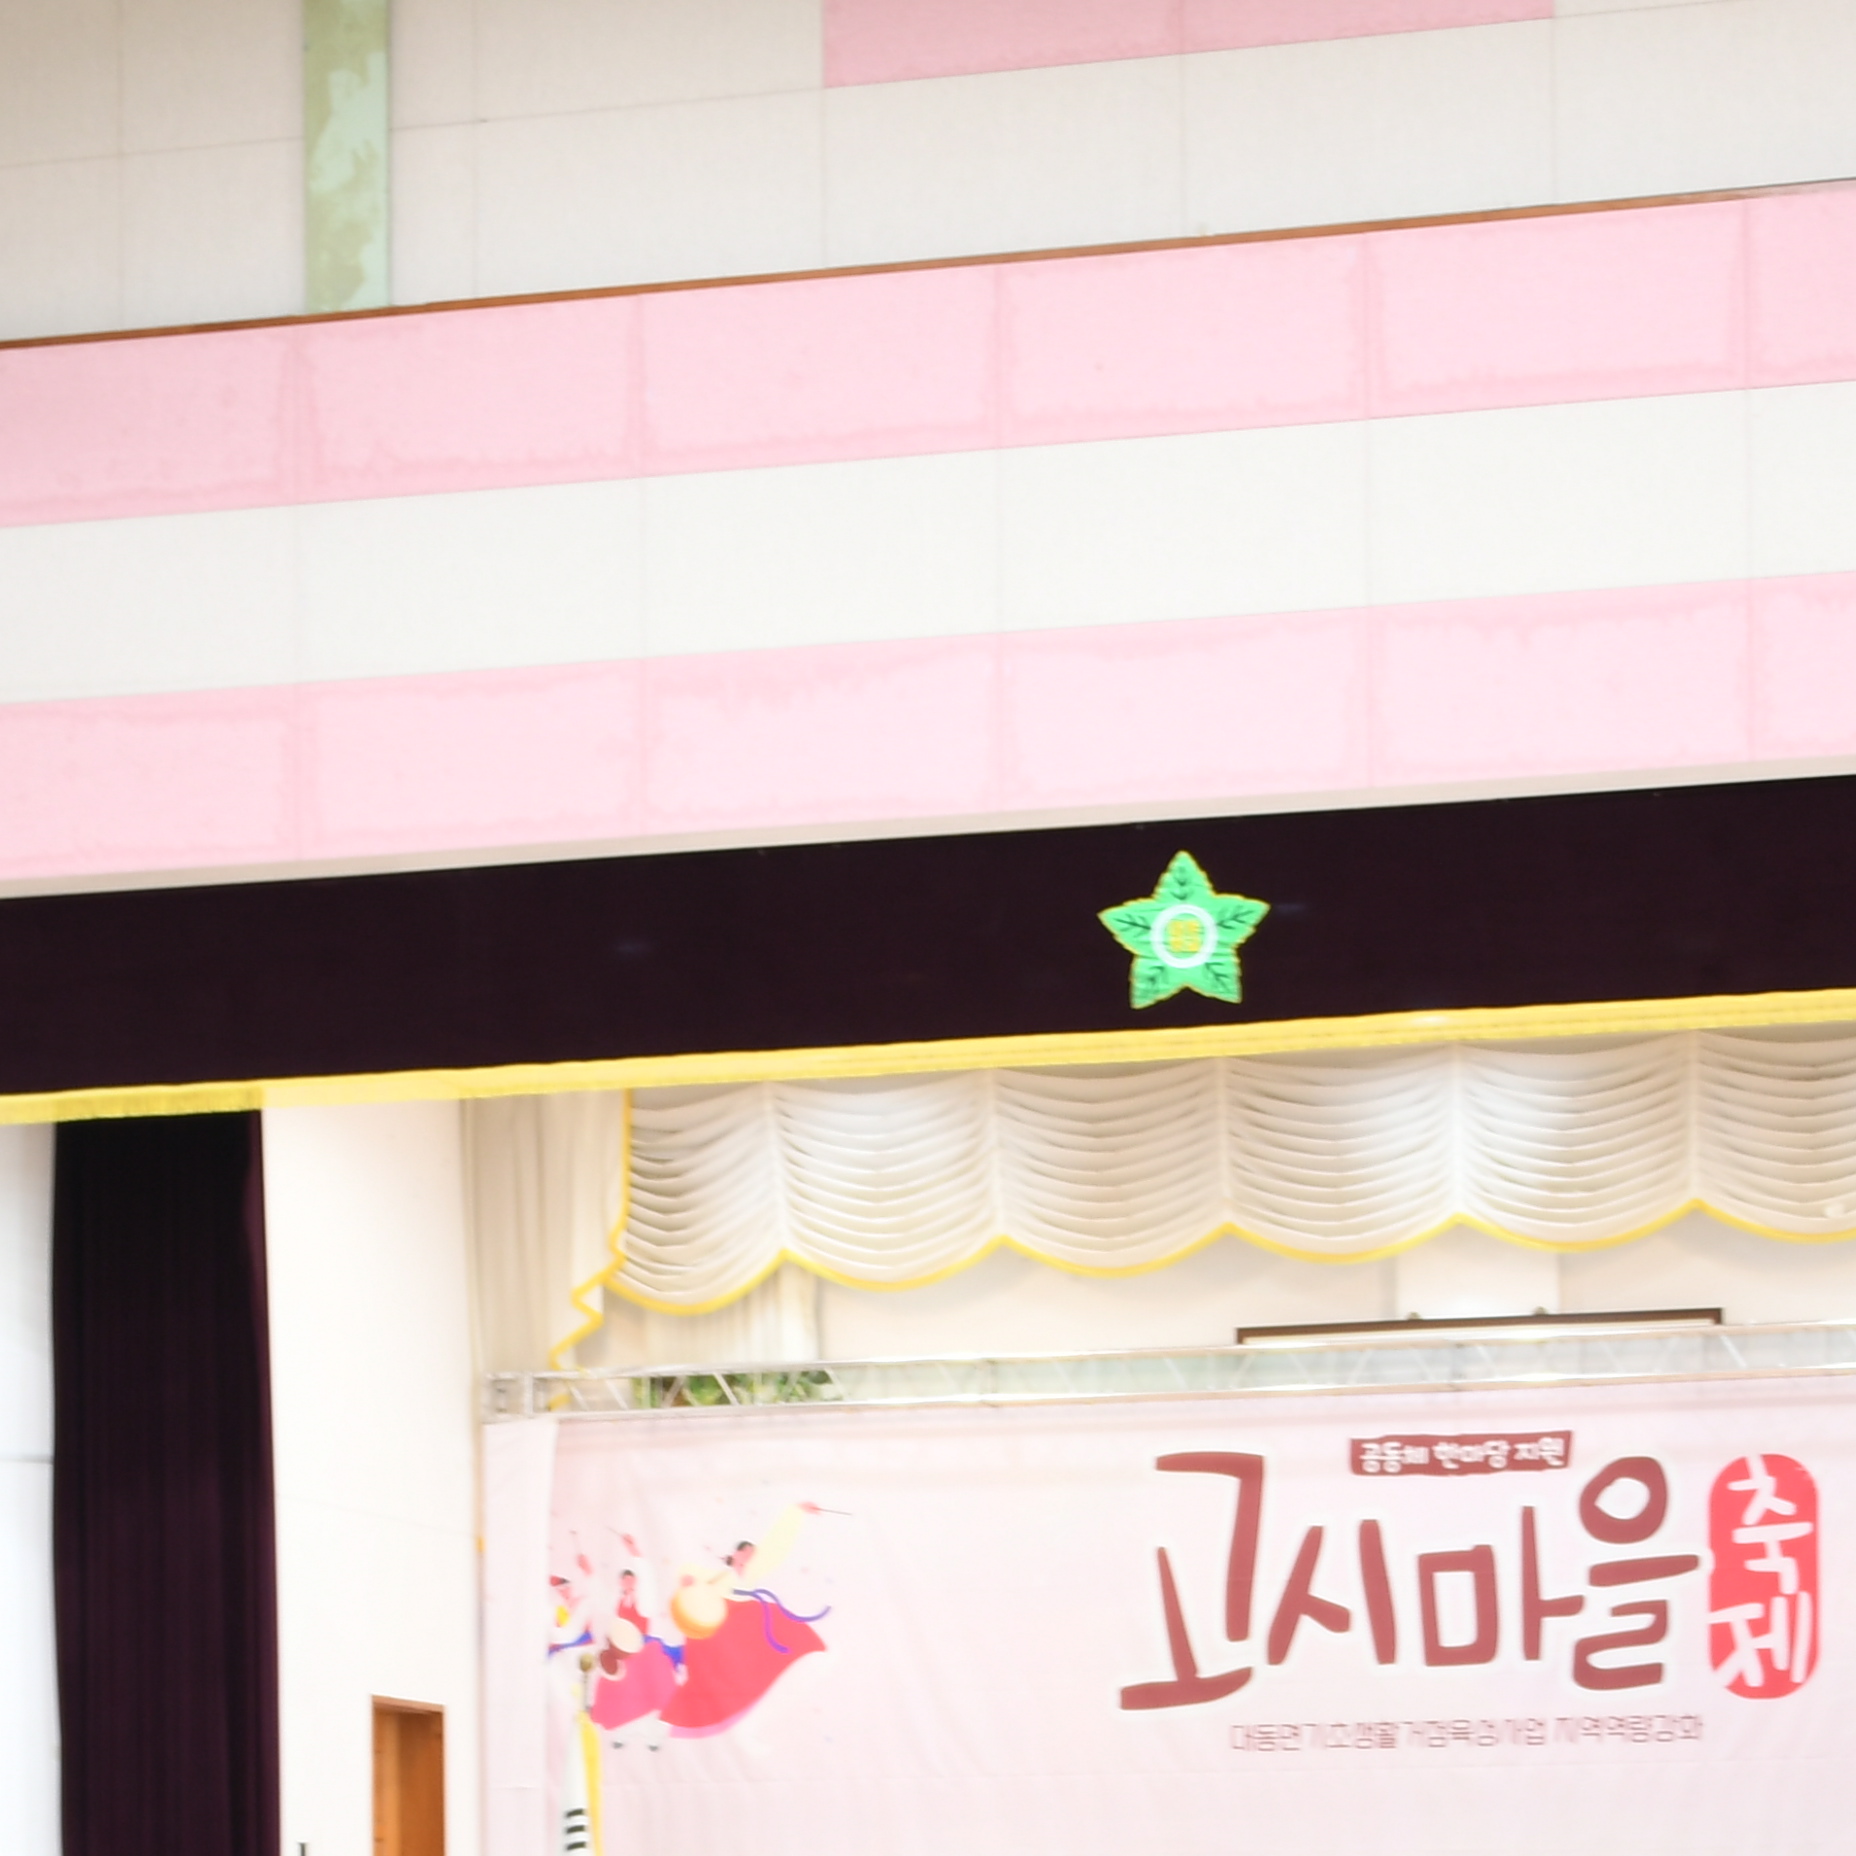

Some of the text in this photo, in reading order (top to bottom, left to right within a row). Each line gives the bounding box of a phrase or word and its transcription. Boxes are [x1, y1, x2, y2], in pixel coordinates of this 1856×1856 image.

[1359, 1436, 1565, 1473] 공동체 한마당 지원
[1706, 1453, 1814, 1688] 축제
[1120, 1451, 1700, 1711] 고시마을
